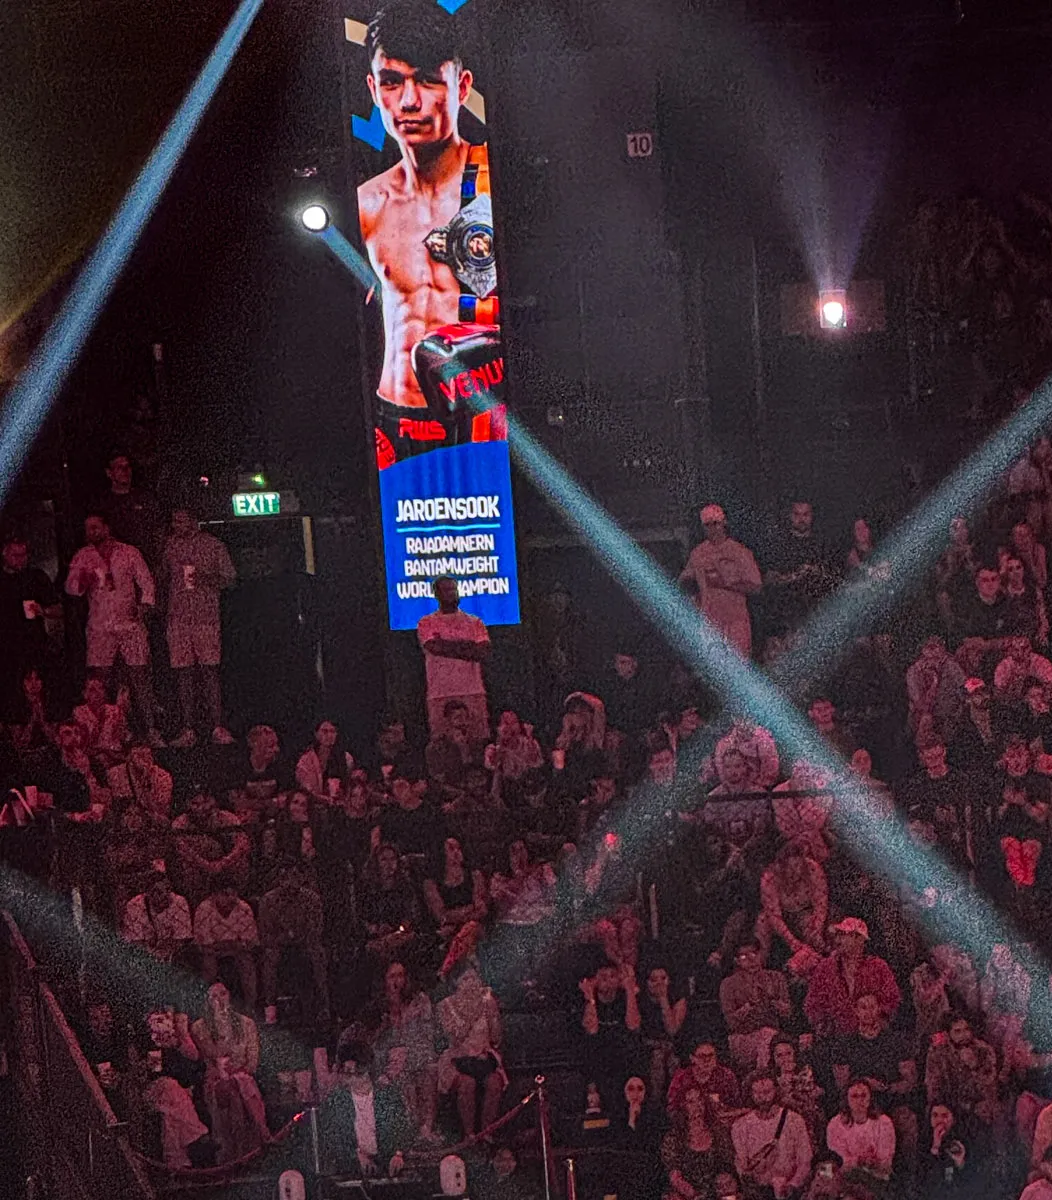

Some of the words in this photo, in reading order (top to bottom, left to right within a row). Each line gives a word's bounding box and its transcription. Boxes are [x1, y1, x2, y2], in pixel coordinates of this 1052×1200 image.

[630, 136, 650, 154] 10
[440, 357, 504, 404] VENU
[235, 494, 276, 513] EXIT
[396, 495, 500, 522] JAROENSOOK
[406, 534, 494, 554] RAJADAMNERN
[404, 556, 499, 576] BANTAMWEIGHT
[397, 582, 436, 600] WORL
